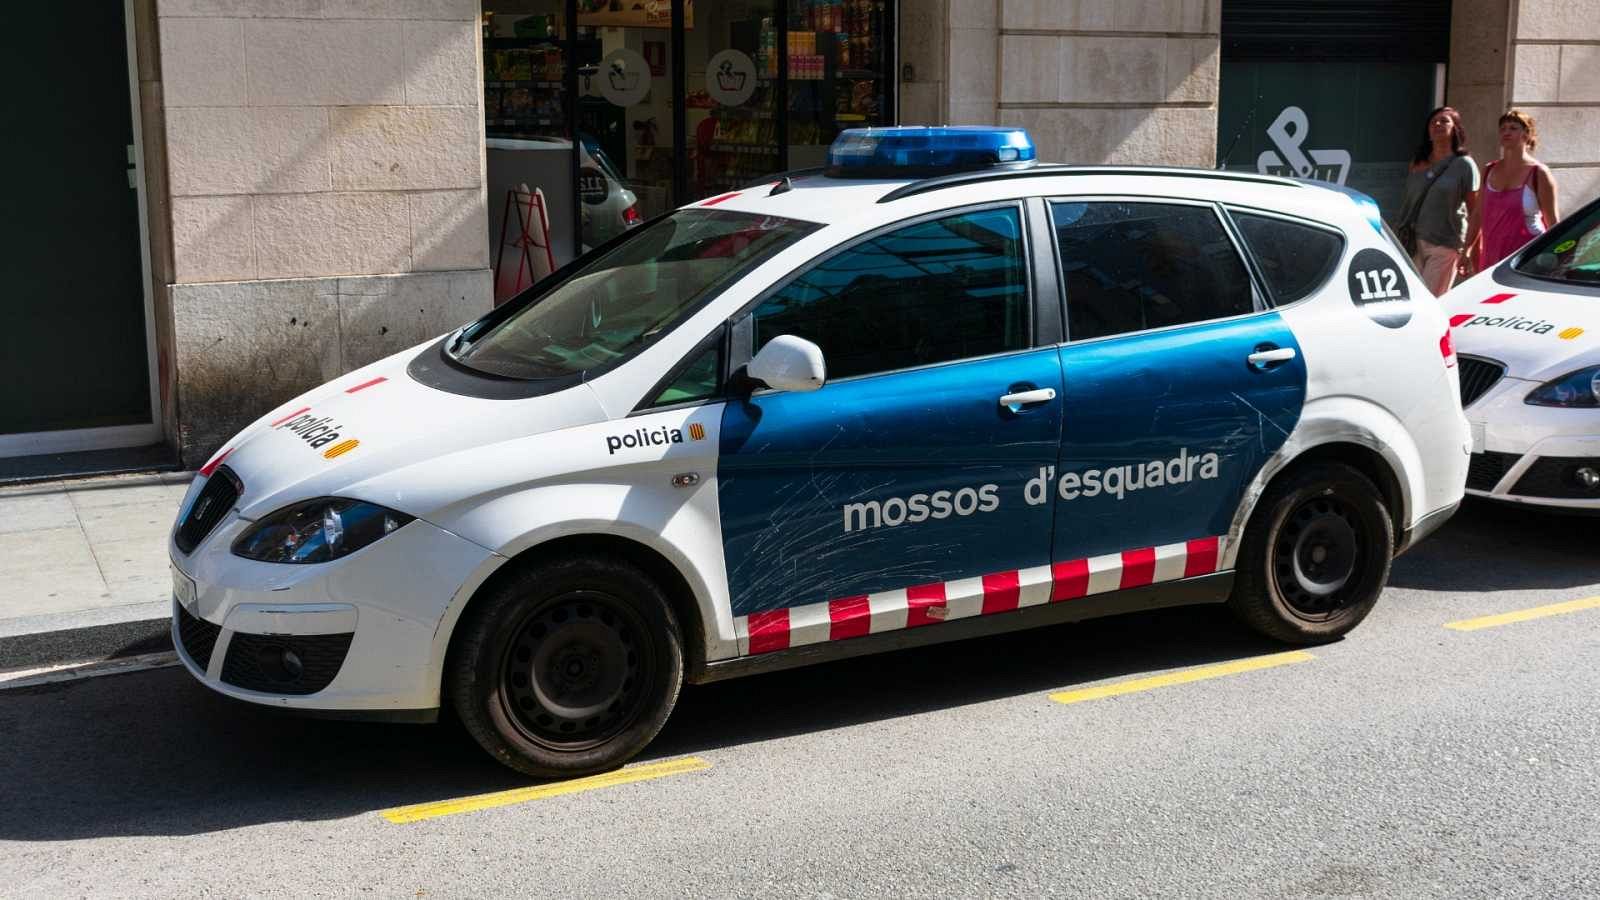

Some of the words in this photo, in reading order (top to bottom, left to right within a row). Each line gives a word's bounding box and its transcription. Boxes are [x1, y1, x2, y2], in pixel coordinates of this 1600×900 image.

[1355, 268, 1402, 300] 112
[1463, 314, 1555, 335] policia
[275, 414, 344, 449] policia
[606, 425, 684, 455] policia
[843, 483, 1000, 532] mossos
[1024, 447, 1220, 506] d'esquadra
